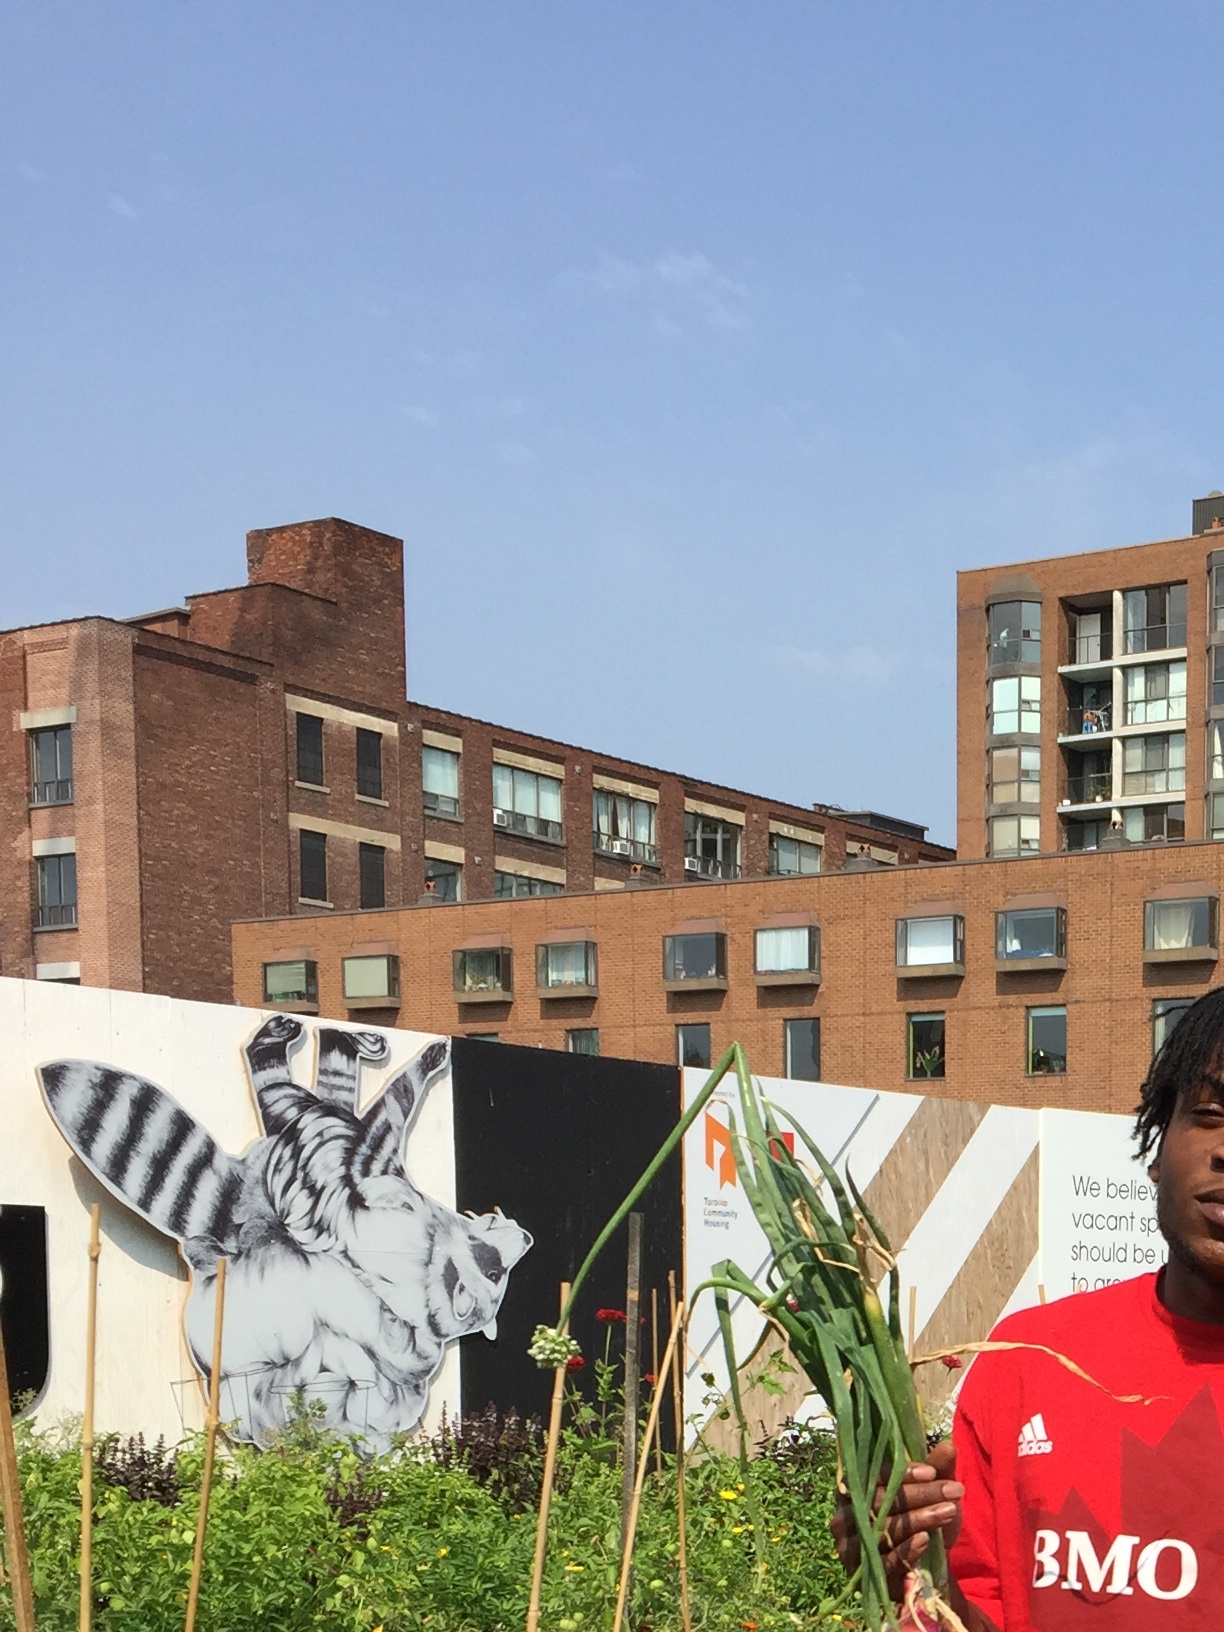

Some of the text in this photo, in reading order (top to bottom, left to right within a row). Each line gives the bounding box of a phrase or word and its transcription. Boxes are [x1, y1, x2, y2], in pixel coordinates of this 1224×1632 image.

[1072, 1174, 1101, 1198] We
[1072, 1211, 1135, 1232] vacant
[1070, 1240, 1127, 1263] should
[1133, 1243, 1156, 1265] be
[1018, 1440, 1053, 1457] didas
[1032, 1529, 1198, 1600] BMO
